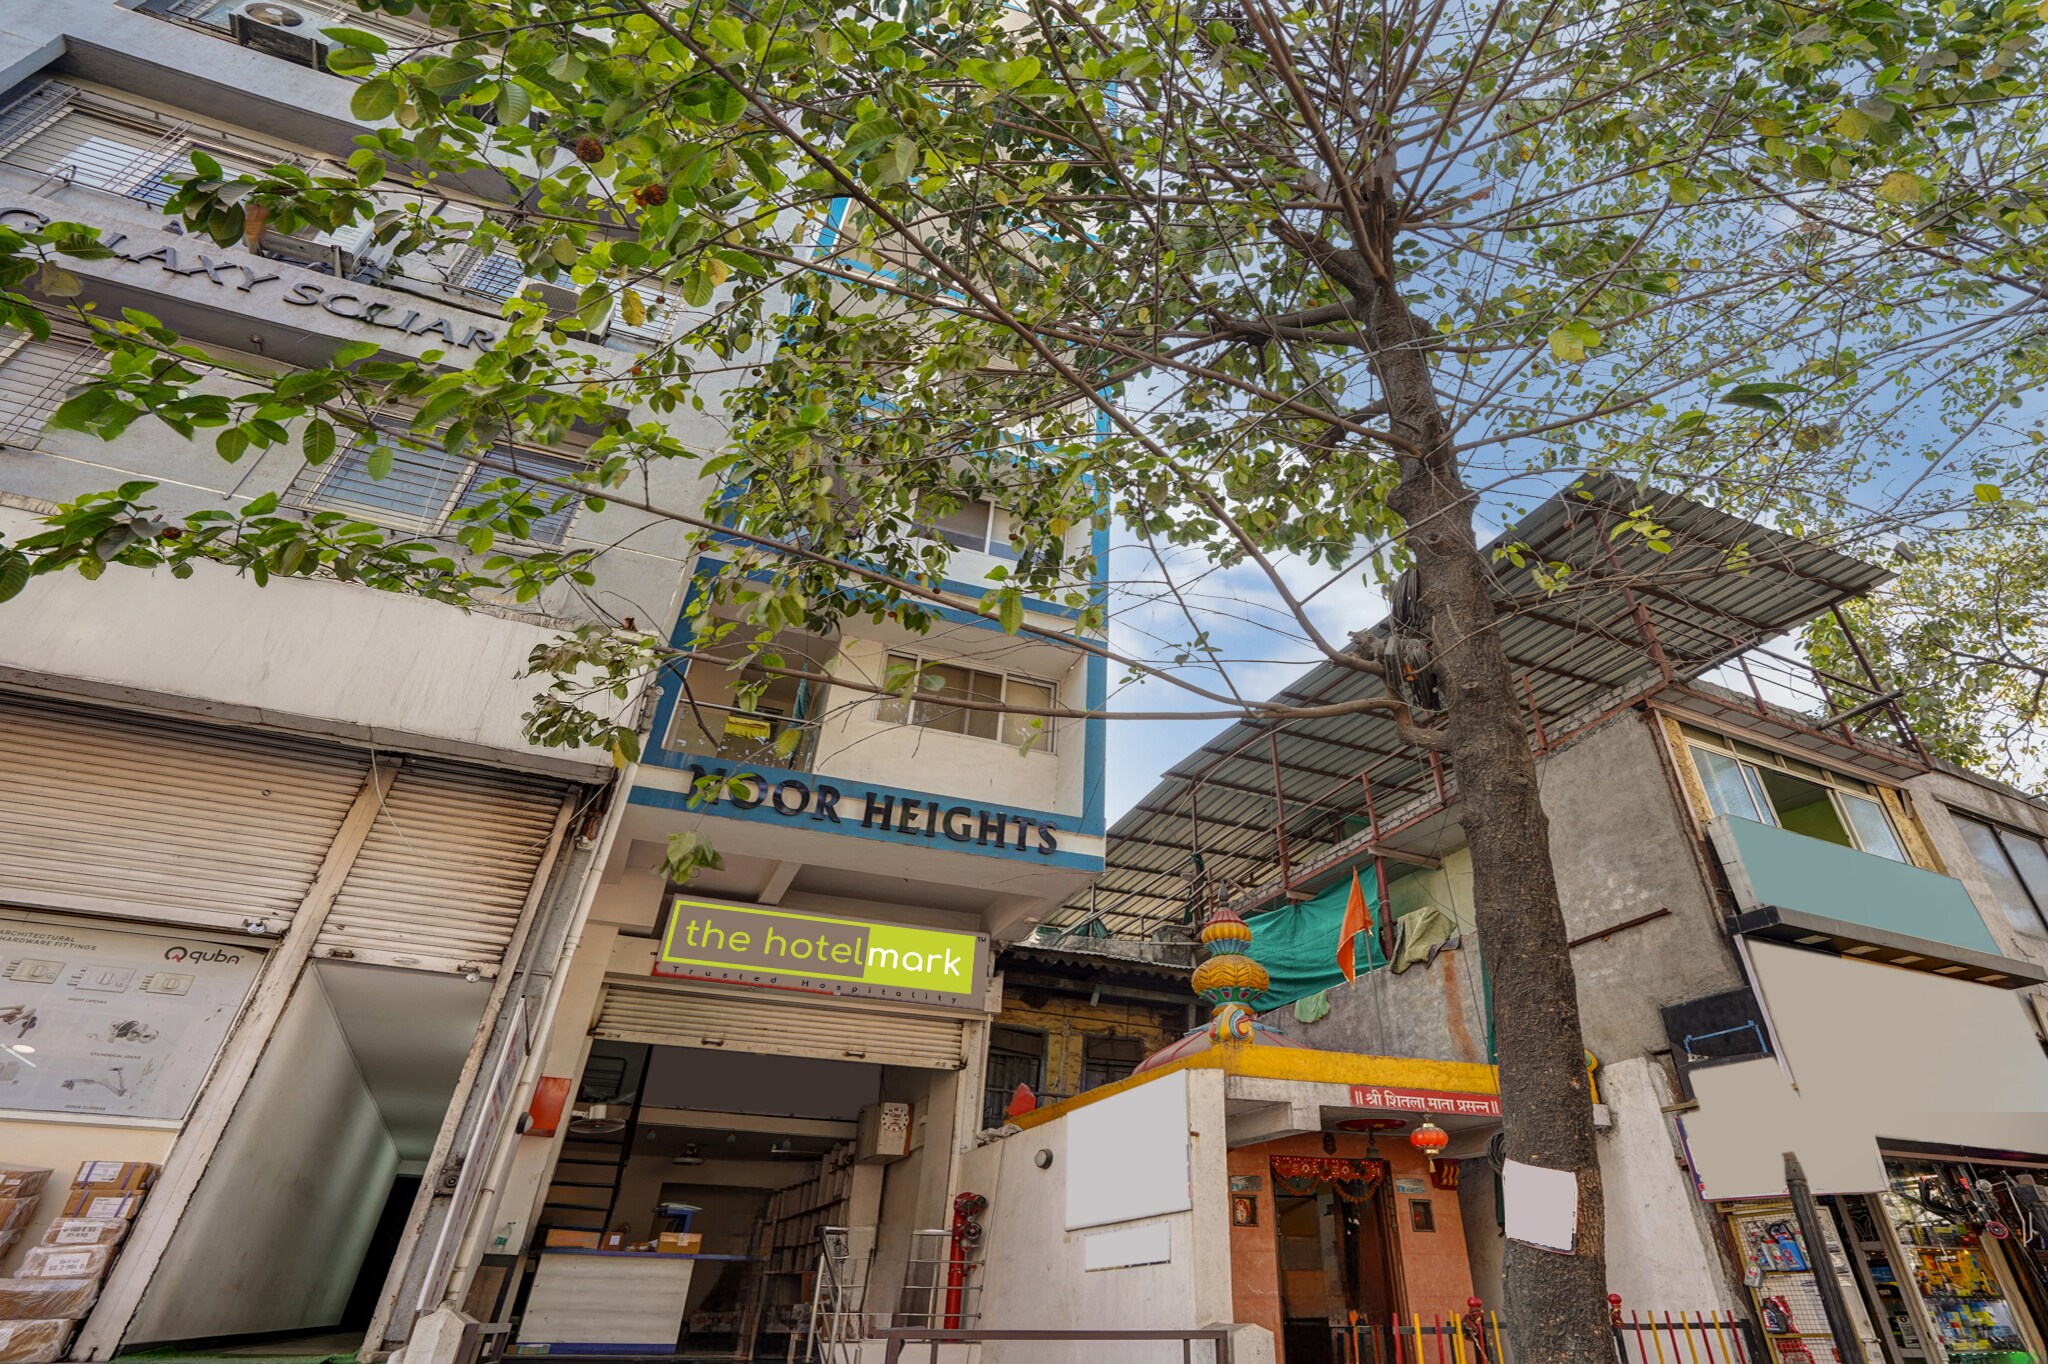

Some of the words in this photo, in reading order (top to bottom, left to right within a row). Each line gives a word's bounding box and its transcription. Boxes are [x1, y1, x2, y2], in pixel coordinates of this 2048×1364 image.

[861, 791, 1058, 855] HEIGHTS
[0, 929, 76, 943] ARCHITECTURAL
[0, 936, 51, 947] HARDWARE
[53, 941, 97, 951] FITTINGS
[686, 919, 751, 952] the
[673, 965, 777, 984] Trusted
[801, 980, 957, 1004] Hospitality
[1365, 1089, 1382, 1106] श्री
[1427, 1097, 1455, 1111] माता
[1456, 1099, 1489, 1113] प्रसन्न
